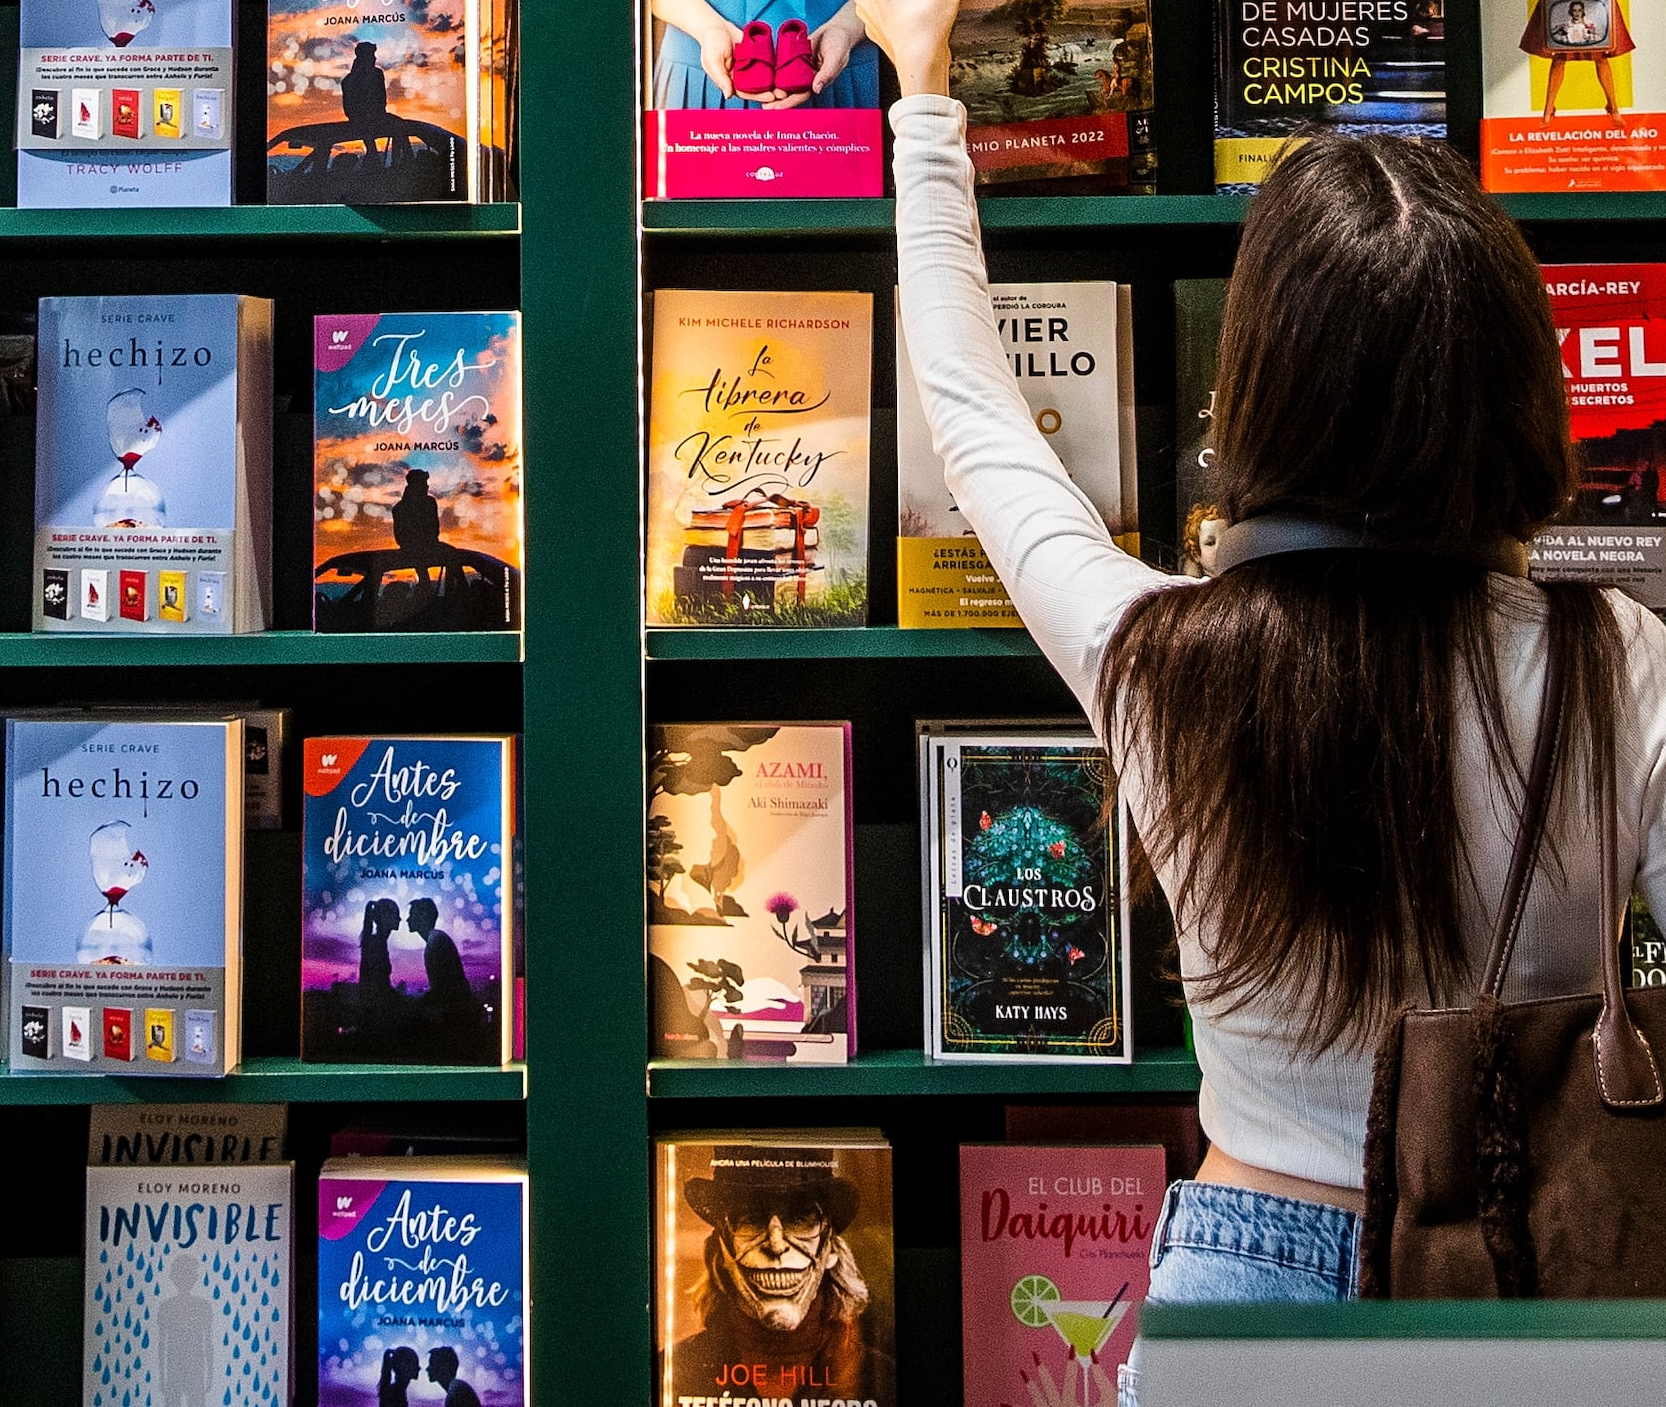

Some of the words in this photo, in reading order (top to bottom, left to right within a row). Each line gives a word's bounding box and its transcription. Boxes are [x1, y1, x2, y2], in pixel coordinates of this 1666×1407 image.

[678, 317, 701, 329] KIM
[705, 317, 763, 329] MICHELE
[766, 318, 851, 330] RICHARDSON
[373, 330, 496, 399] Tres
[329, 390, 489, 435] meses
[374, 441, 409, 452] JOANA
[412, 440, 459, 451] MARCÚS
[1017, 867, 1041, 880] LOS
[964, 884, 1097, 911] CLAUSTROS
[995, 1003, 1030, 1020] KATY
[1034, 1005, 1067, 1021] HAYS
[137, 1182, 171, 1194] ELOY
[178, 1183, 241, 1194] MORENO
[99, 1203, 283, 1247] INVISIBLE
